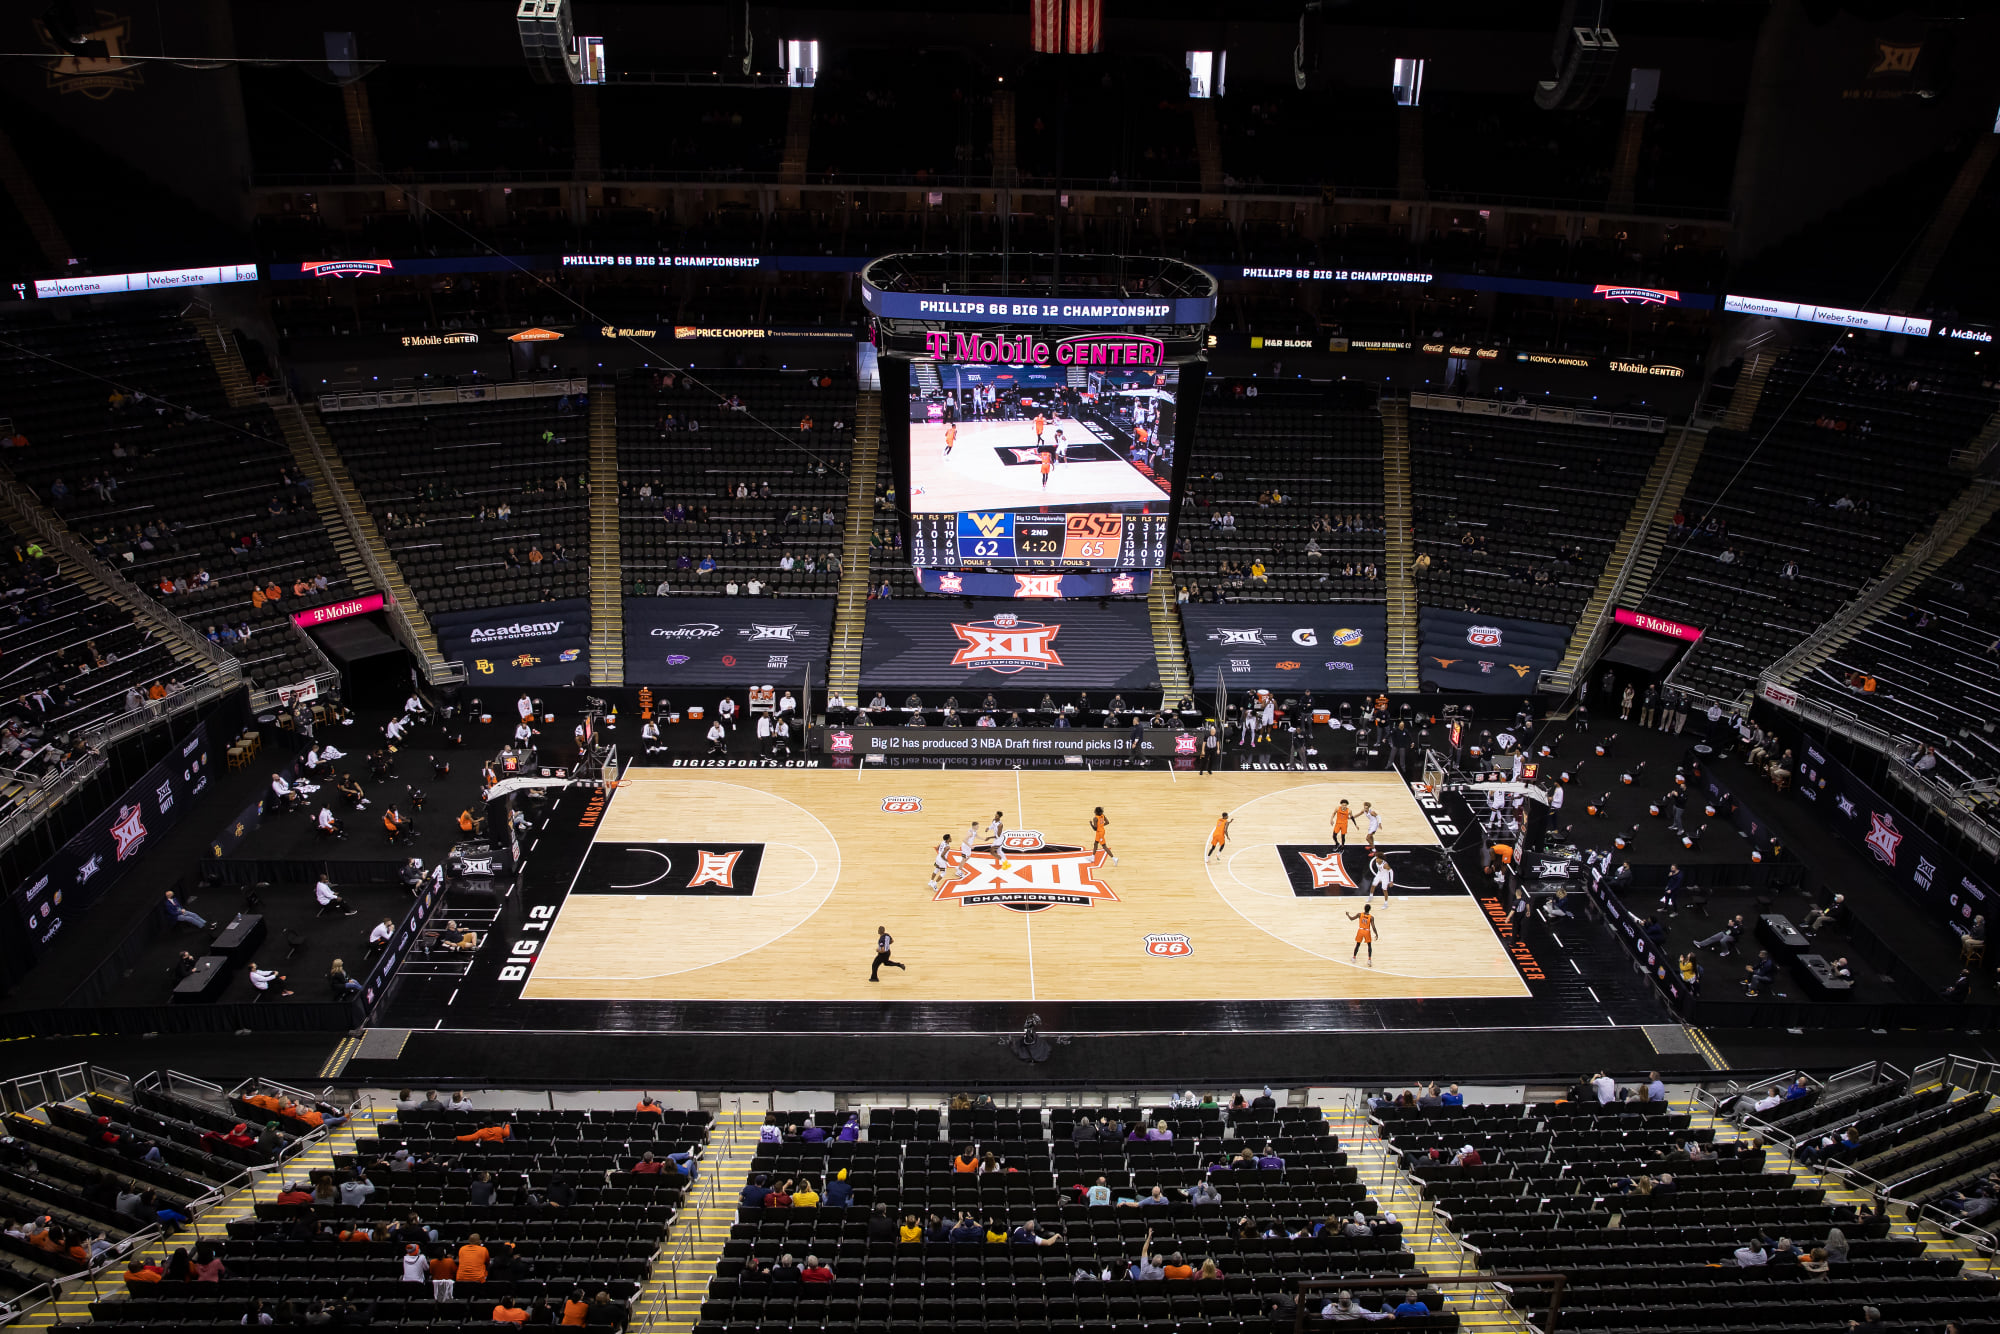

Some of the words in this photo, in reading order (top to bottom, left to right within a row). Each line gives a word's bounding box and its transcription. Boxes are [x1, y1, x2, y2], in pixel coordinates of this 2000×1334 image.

[321, 263, 375, 271] CHAMPIONSHIP
[562, 256, 615, 265] PHILLIPS
[617, 256, 633, 265] 66
[636, 256, 656, 266] BIG
[658, 256, 671, 266] 12
[674, 257, 760, 267] CHAMPIONSHIP
[59, 282, 100, 293] Montana
[151, 276, 180, 285] Weber
[182, 274, 204, 283] State
[238, 272, 257, 280] 9:00
[1242, 268, 1293, 279] PHILLIPS
[1295, 269, 1310, 279] 66
[1313, 270, 1333, 280] BIG
[1335, 270, 1348, 280] 12
[1350, 271, 1433, 283] CHAMPIONSHIP
[1611, 289, 1662, 299] CHAMPIONSHIP
[920, 300, 985, 314] PHILLIPS
[989, 302, 1008, 315] 66
[1012, 303, 1038, 316] BIG
[1042, 304, 1059, 316] 12
[1063, 304, 1170, 318] CHAMPIONSHIP
[1743, 302, 1778, 313] Montana
[1817, 311, 1846, 322] Weber
[1846, 314, 1868, 325] State
[1907, 326, 1927, 335] 9:00
[411, 335, 442, 346] Mobile
[443, 333, 479, 345] CENTER
[696, 329, 722, 338] PRICE
[723, 329, 765, 339] CHOPPER
[1938, 327, 1946, 337] 4
[1951, 328, 1992, 342] McBride
[953, 332, 1049, 364] Mobile
[1056, 333, 1164, 366] CENTER
[1265, 339, 1283, 347] H&R
[1284, 339, 1313, 348] BLOCK
[1529, 355, 1557, 364] KONICA
[1558, 358, 1589, 367] MINOLTA
[1618, 362, 1648, 374] Mobile
[1649, 364, 1685, 377] CENTER
[916, 521, 922, 530] 1
[932, 521, 938, 530] 1
[945, 521, 954, 530] 11
[1127, 523, 1135, 531] 0
[1142, 523, 1149, 531] 3
[1155, 523, 1166, 531] 14
[916, 530, 923, 539] 4
[931, 530, 938, 539] 0
[945, 530, 955, 539] 19
[1126, 532, 1134, 540] 2
[1143, 532, 1148, 540] 1
[1155, 532, 1165, 540] 17
[916, 539, 924, 548] 11
[932, 539, 938, 548] 1
[946, 539, 953, 548] 6
[974, 541, 999, 556] 62
[1022, 540, 1057, 552] 4:20
[1081, 542, 1104, 556] 65
[1125, 541, 1135, 549] 13
[1143, 541, 1148, 549] 1
[1156, 541, 1163, 549] 6
[914, 548, 924, 556] 12
[932, 548, 938, 556] 1
[945, 548, 954, 556] 14
[1124, 549, 1135, 558] 14
[1141, 549, 1148, 558] 0
[1153, 549, 1164, 558] 10
[913, 557, 926, 565] 22
[931, 557, 938, 565] 2
[944, 557, 955, 565] 10
[1122, 558, 1135, 566] 22
[1142, 558, 1146, 566] 1
[1155, 558, 1161, 566] 5
[1015, 574, 1062, 597] XII
[326, 602, 363, 620] Mobile
[470, 621, 561, 638] Academy
[752, 625, 792, 640] XII
[1646, 616, 1683, 636] Mobile
[1221, 629, 1263, 643] XII
[1291, 628, 1318, 646] G
[1333, 629, 1364, 646] Sunkist
[960, 630, 1054, 660] XII
[475, 659, 494, 674] BU
[1325, 661, 1354, 671] TCU
[1764, 686, 1796, 706] ESPN
[833, 736, 852, 748] XII
[871, 737, 887, 749] Big
[890, 738, 900, 748] 12
[902, 738, 919, 748] has
[922, 738, 969, 750] produced
[970, 738, 978, 748] 3
[980, 738, 1003, 749] NBA
[1005, 738, 1030, 749] Draft
[1032, 738, 1053, 749] first
[1054, 738, 1083, 749] round
[1085, 738, 1111, 751] picks
[1113, 739, 1123, 749] 13
[1125, 739, 1155, 749] ties.
[1176, 739, 1196, 750] XII
[672, 759, 819, 768] BIG12SPORTS.COM
[578, 796, 605, 827] KANSAS
[888, 802, 915, 811] 66
[1430, 814, 1460, 836] 12
[113, 808, 145, 858] XII
[1008, 838, 1034, 846] 66
[463, 859, 491, 875] XII
[691, 851, 739, 887] XII
[950, 855, 1101, 893] XII
[1303, 854, 1355, 888] XII
[1542, 861, 1569, 877] XII
[972, 894, 1081, 904] CHAMPIONSHIP
[1950, 893, 1959, 906] G
[29, 914, 38, 929] G
[498, 940, 540, 981] BIG
[522, 905, 557, 931] 12
[1154, 943, 1183, 953] 66
[1508, 941, 1546, 980] CENTER
